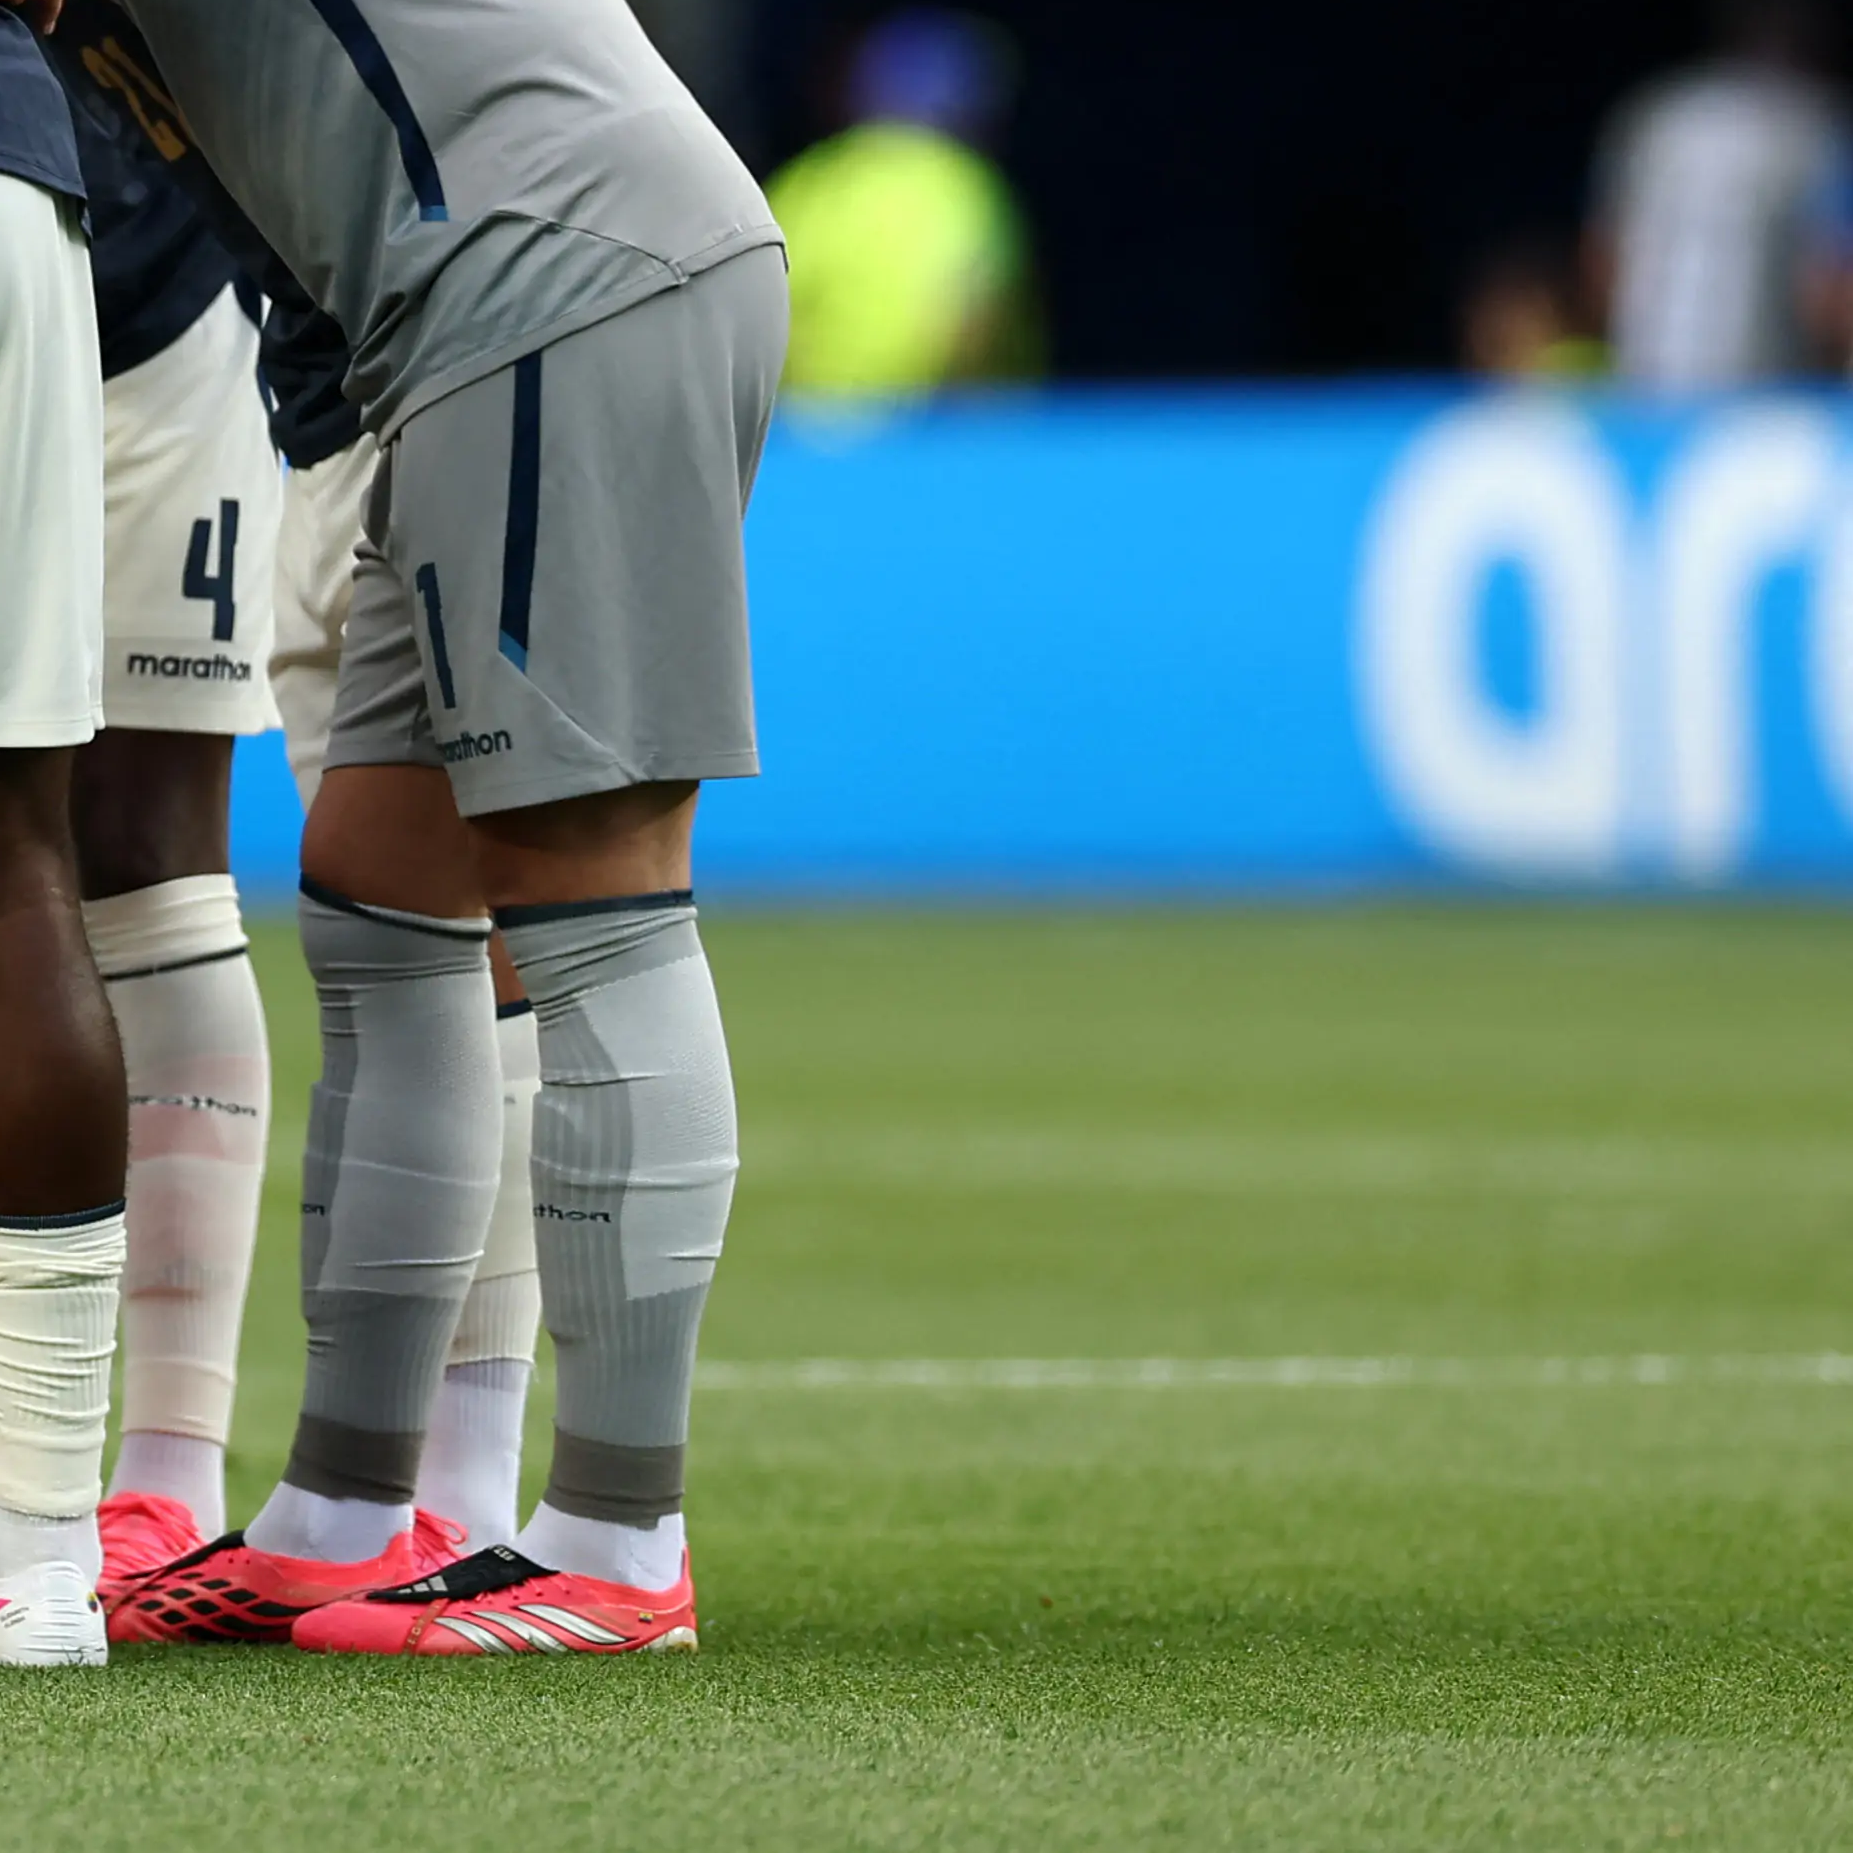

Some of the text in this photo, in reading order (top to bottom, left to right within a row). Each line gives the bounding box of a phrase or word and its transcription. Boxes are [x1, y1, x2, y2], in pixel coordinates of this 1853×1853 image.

[182, 499, 239, 641] 4
[415, 562, 456, 709] 1
[1352, 387, 1853, 885] ar
